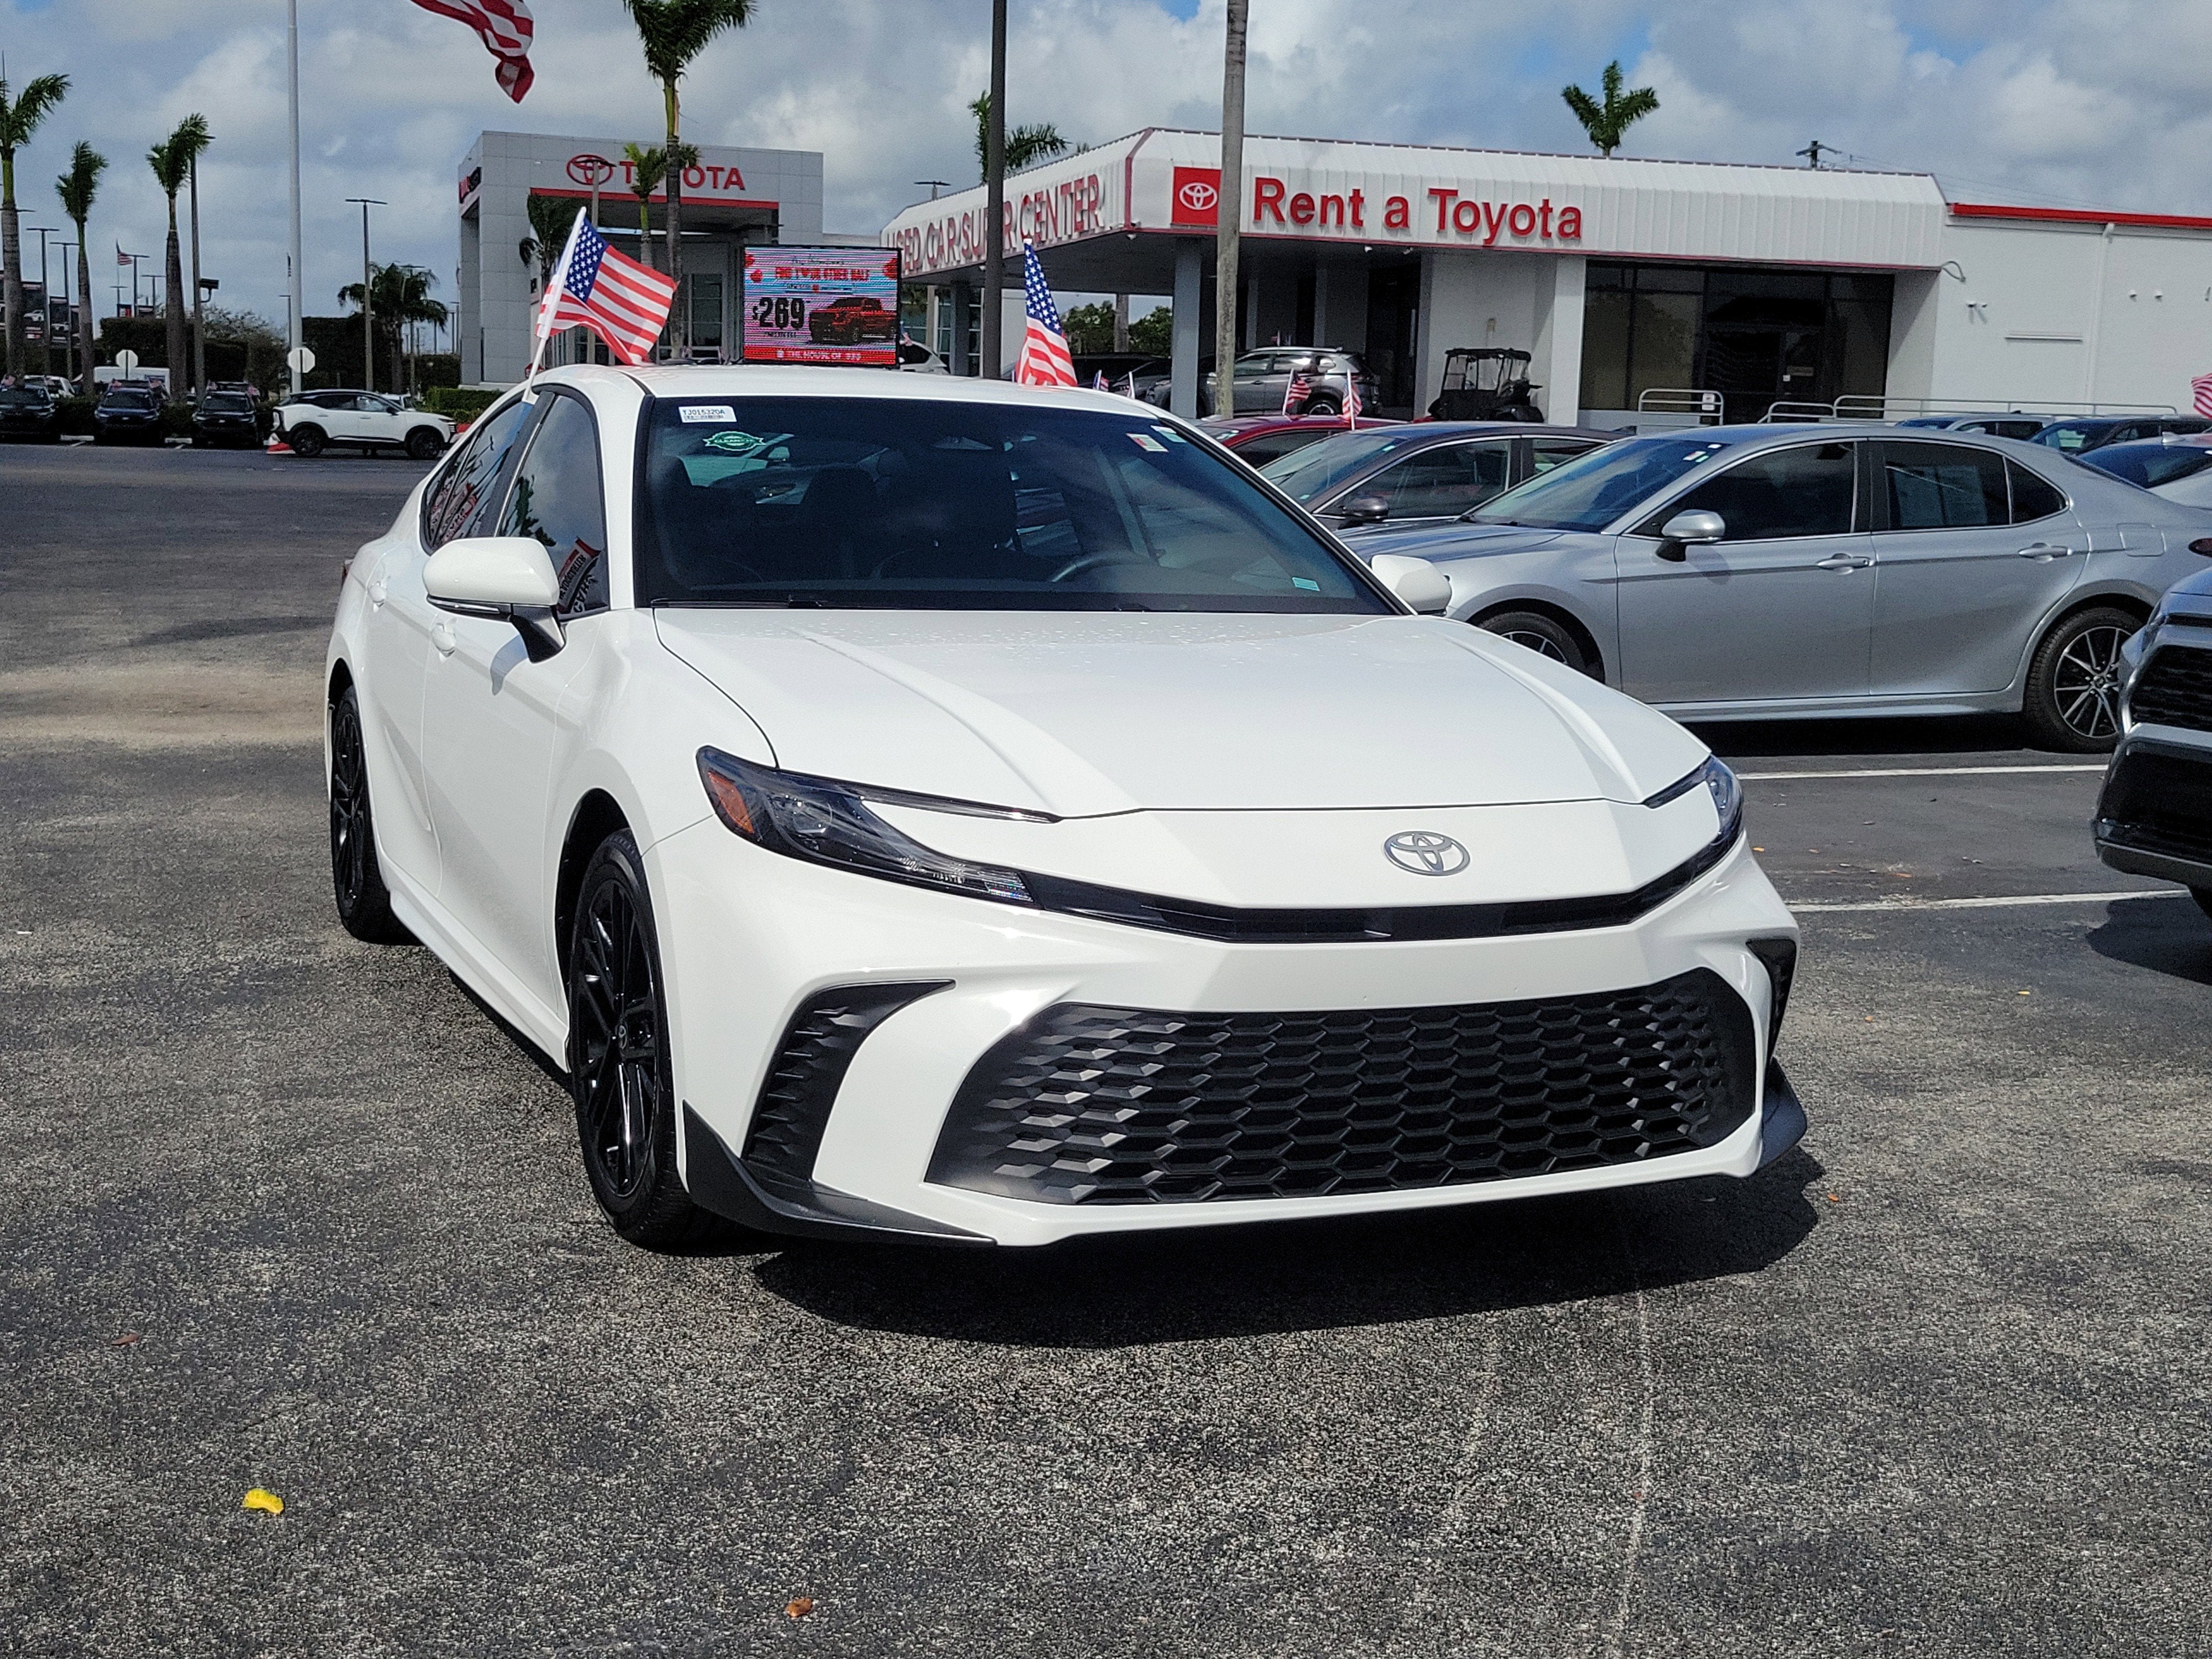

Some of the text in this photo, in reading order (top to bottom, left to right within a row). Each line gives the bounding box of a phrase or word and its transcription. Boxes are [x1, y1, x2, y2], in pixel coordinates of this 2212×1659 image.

[619, 161, 745, 190] TOTA
[927, 217, 956, 267] CAR
[962, 201, 1013, 257] SUR
[1020, 174, 1099, 240] CENTER
[1252, 177, 1582, 246] Rent a Toyota
[752, 297, 805, 330] $269
